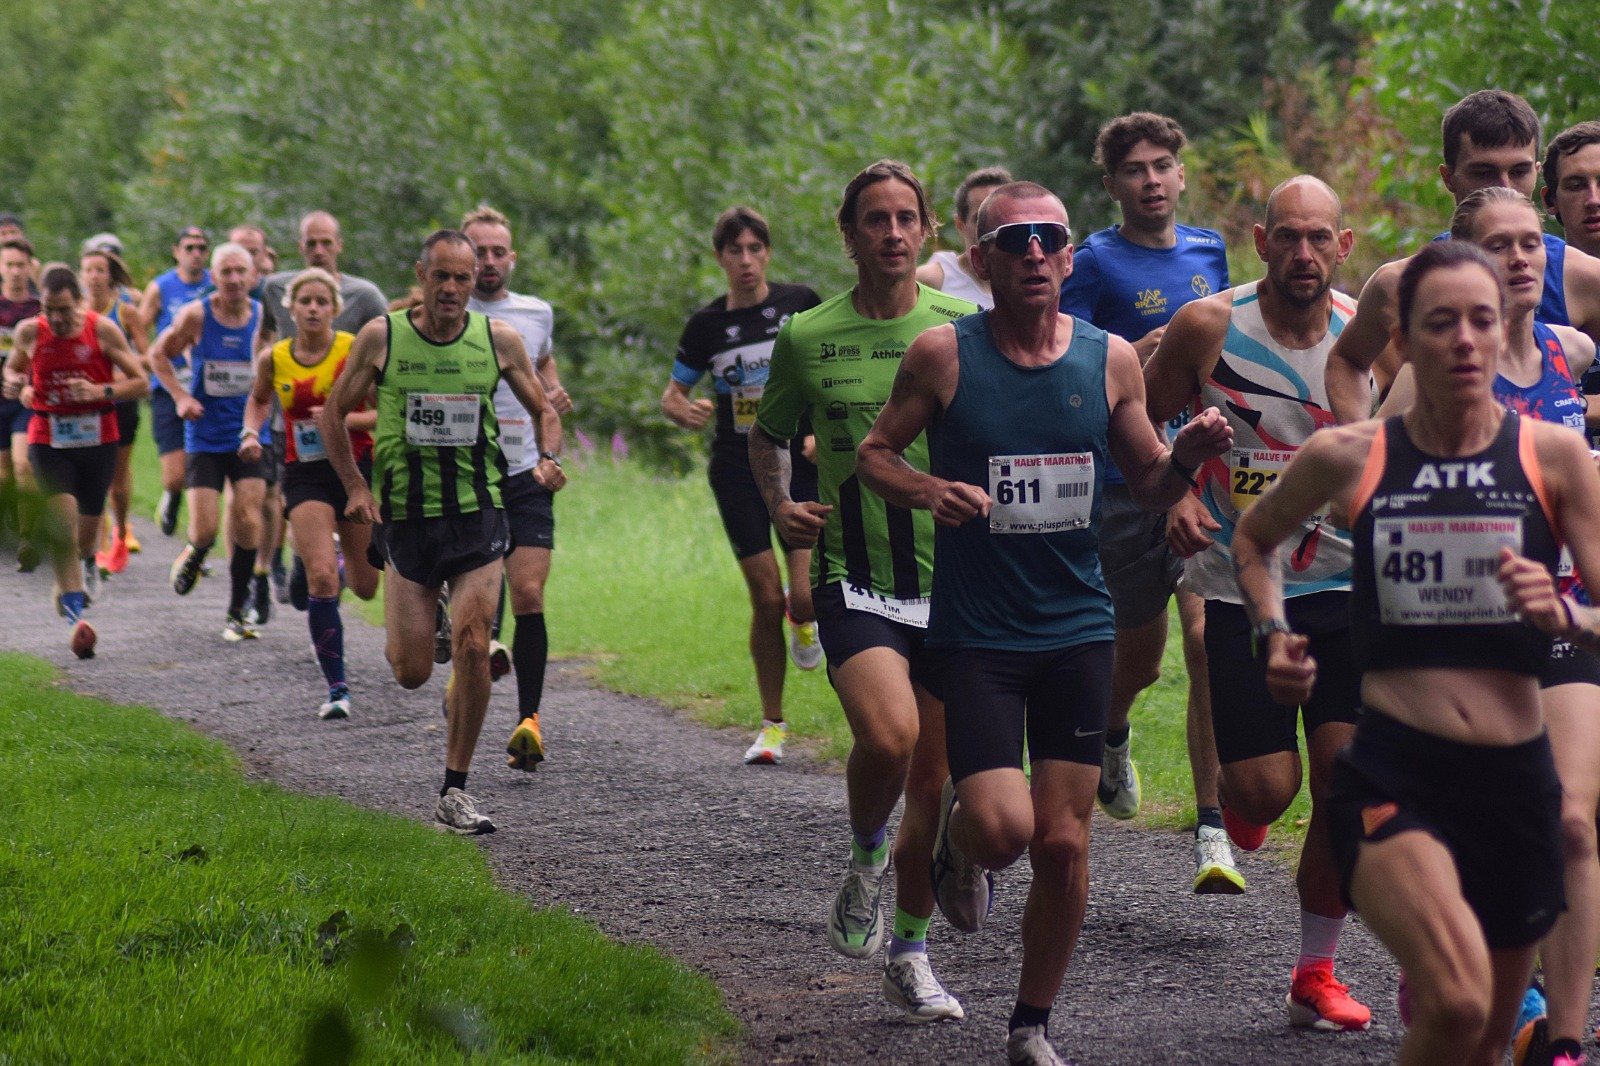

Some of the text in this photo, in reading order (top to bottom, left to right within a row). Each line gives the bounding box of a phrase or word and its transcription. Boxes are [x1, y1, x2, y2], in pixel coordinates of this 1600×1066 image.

[838, 347, 861, 357] press
[833, 378, 863, 386] EXPERTS
[1554, 398, 1576, 408] CRAFT
[410, 409, 445, 426] 459
[433, 427, 453, 436] PAUL
[1014, 457, 1042, 467] HALVE
[1044, 455, 1091, 466] MARATHON
[1254, 452, 1281, 462] HALVE
[1412, 461, 1497, 489] ATK
[996, 478, 1040, 505] 611
[1407, 521, 1446, 534] HALVE
[1449, 521, 1516, 533] MARATHON
[1382, 550, 1443, 583] 481
[1418, 587, 1473, 603] WENDY
[882, 603, 901, 614] TIM
